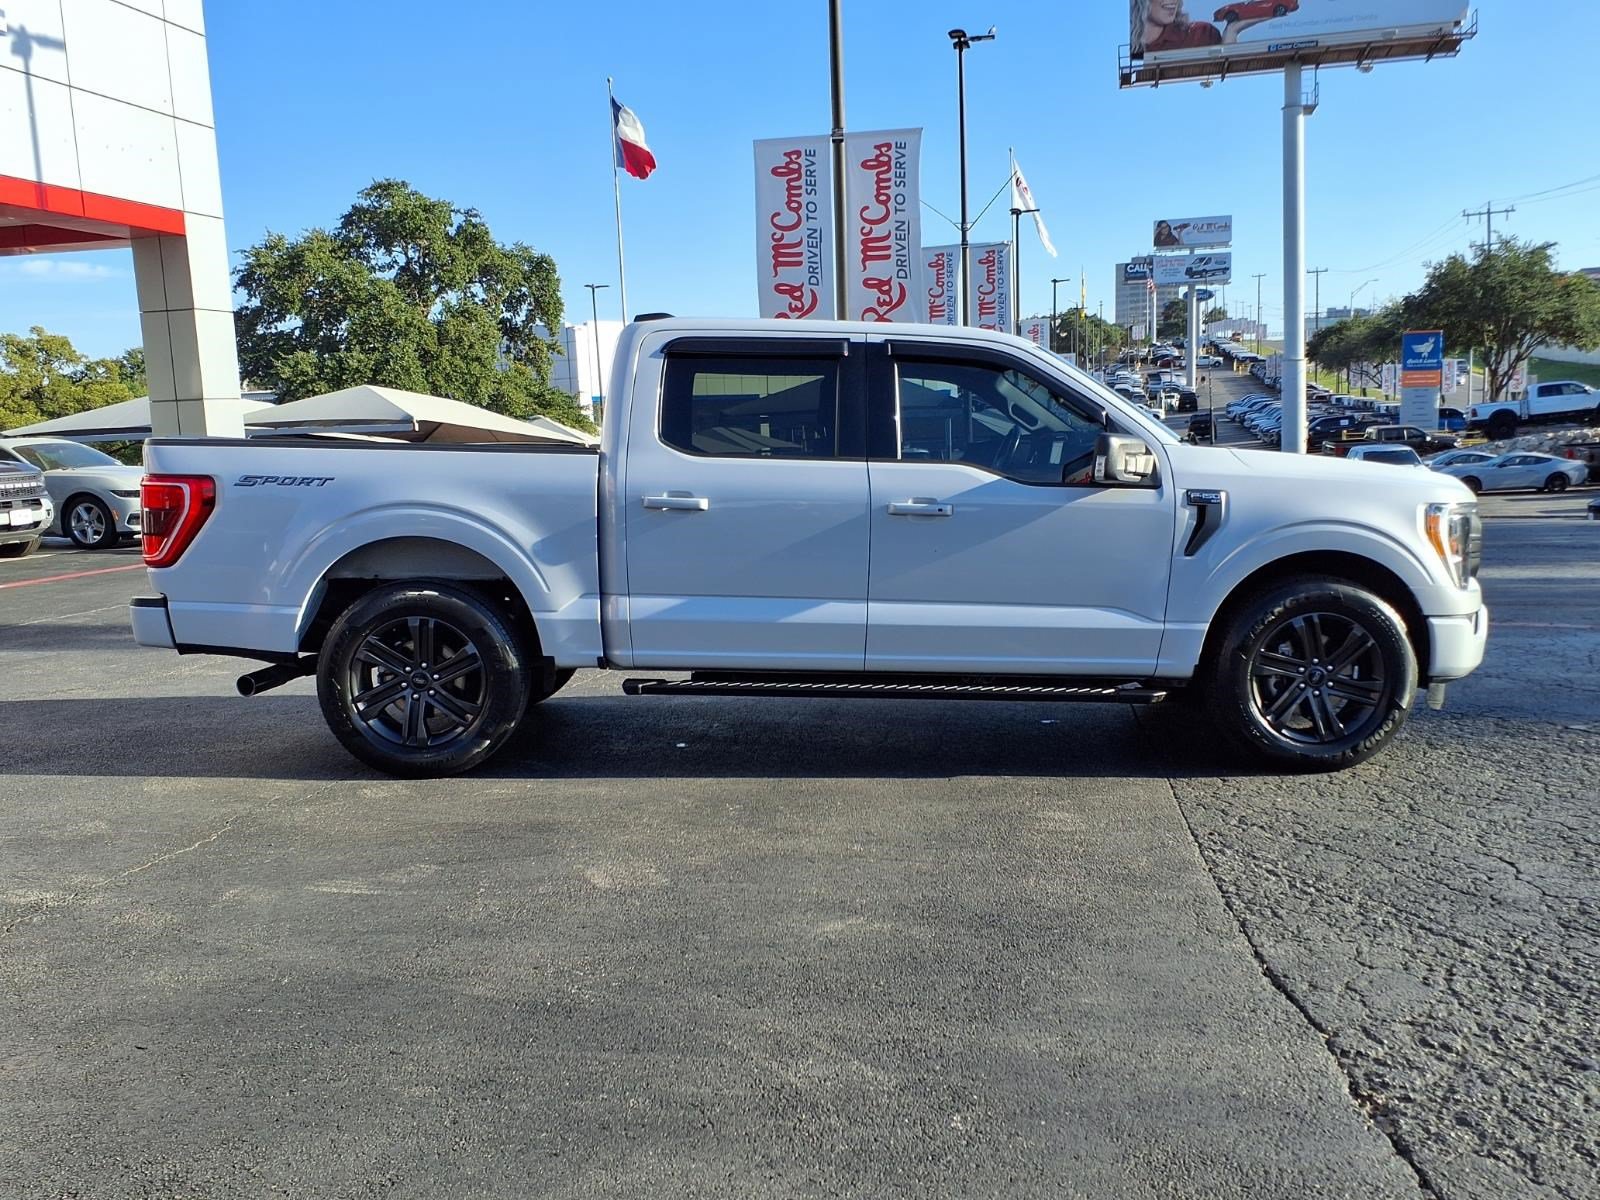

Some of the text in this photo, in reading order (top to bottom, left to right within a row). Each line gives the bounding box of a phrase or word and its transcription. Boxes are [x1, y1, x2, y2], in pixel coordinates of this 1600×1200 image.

[770, 149, 804, 278] McCombs
[804, 148, 820, 286] DRIVEN TO SERVE
[859, 142, 893, 272] McCombs
[894, 141, 908, 279] DRIVEN TO SERVE
[927, 252, 946, 323] McCombs
[945, 251, 953, 280] SERVE
[946, 282, 954, 293] TO
[977, 250, 997, 321] McCombs
[997, 278, 1005, 289] TO
[997, 295, 1006, 325] DRIVEN
[233, 475, 335, 487] SPORT
